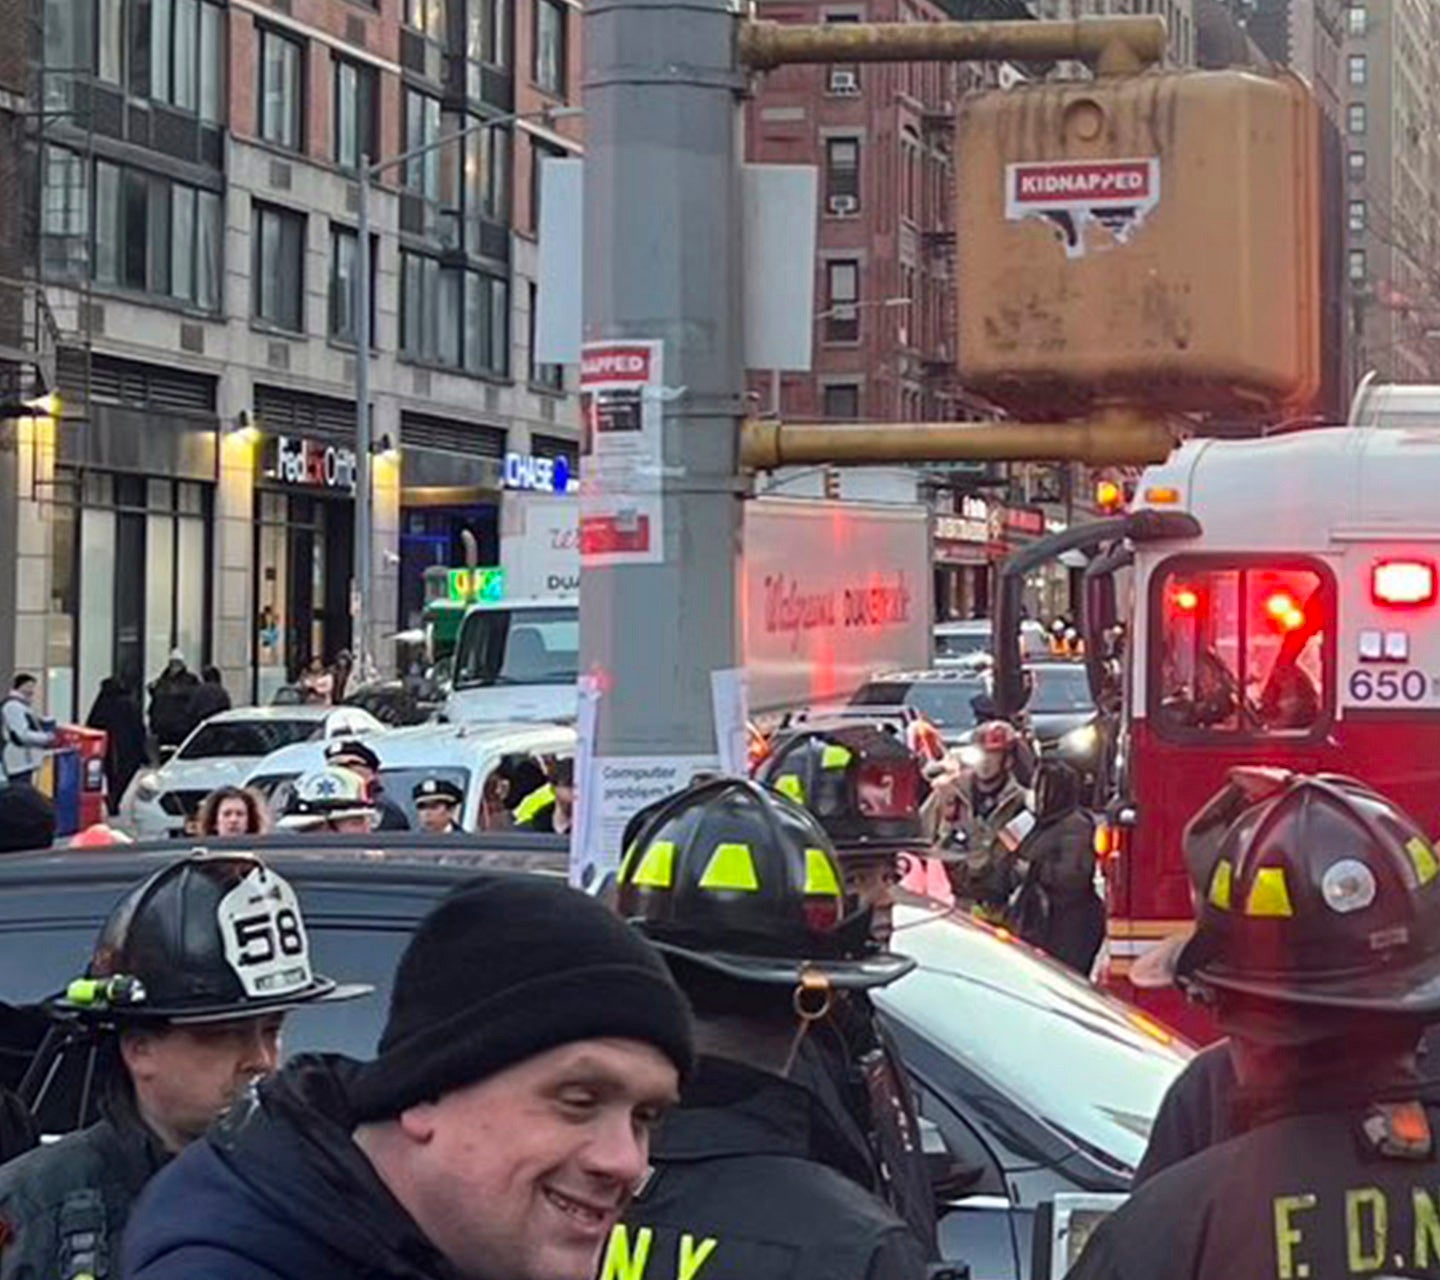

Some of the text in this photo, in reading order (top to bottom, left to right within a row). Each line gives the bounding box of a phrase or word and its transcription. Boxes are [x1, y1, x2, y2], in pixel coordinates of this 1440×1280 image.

[1021, 171, 1143, 193] KIDNAPPED
[505, 452, 555, 489] CHASE
[547, 575, 581, 590] DUA
[1349, 669, 1427, 702] 650
[602, 766, 676, 781] Computer
[233, 908, 303, 967] 58
